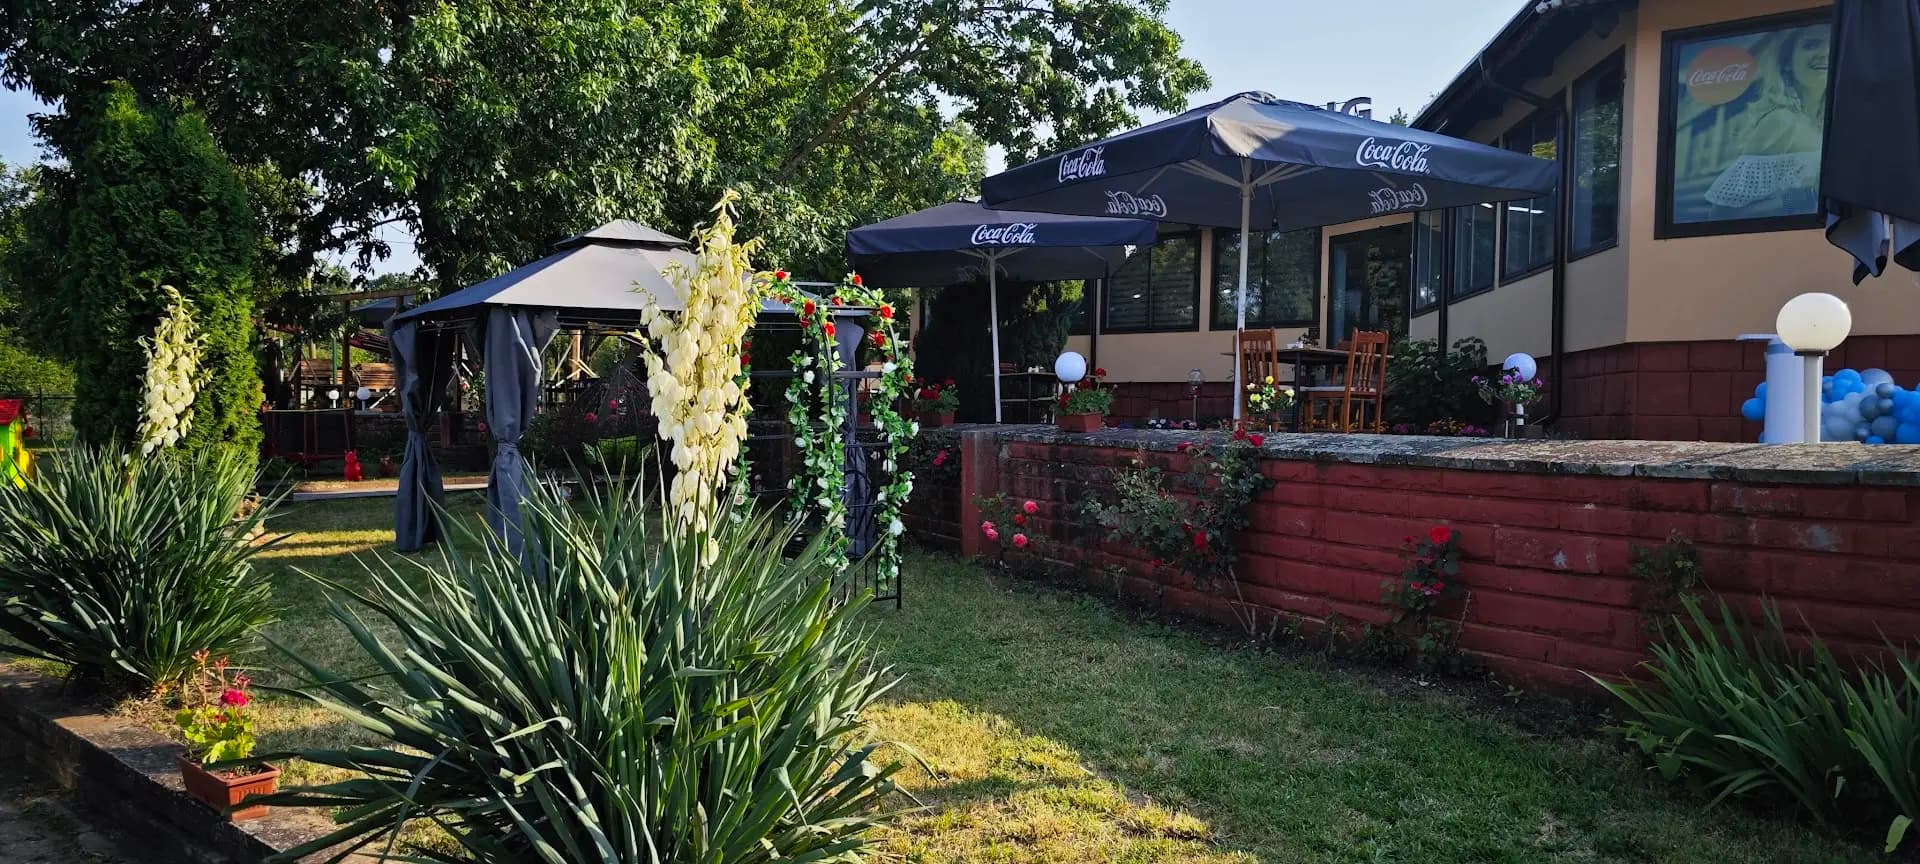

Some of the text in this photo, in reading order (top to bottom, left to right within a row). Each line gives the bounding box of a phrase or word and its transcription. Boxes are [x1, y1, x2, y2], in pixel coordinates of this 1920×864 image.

[1058, 146, 1105, 183] Coca-Cola
[1356, 137, 1431, 173] Coca-Cola
[971, 223, 1038, 245] Coca-Cola
